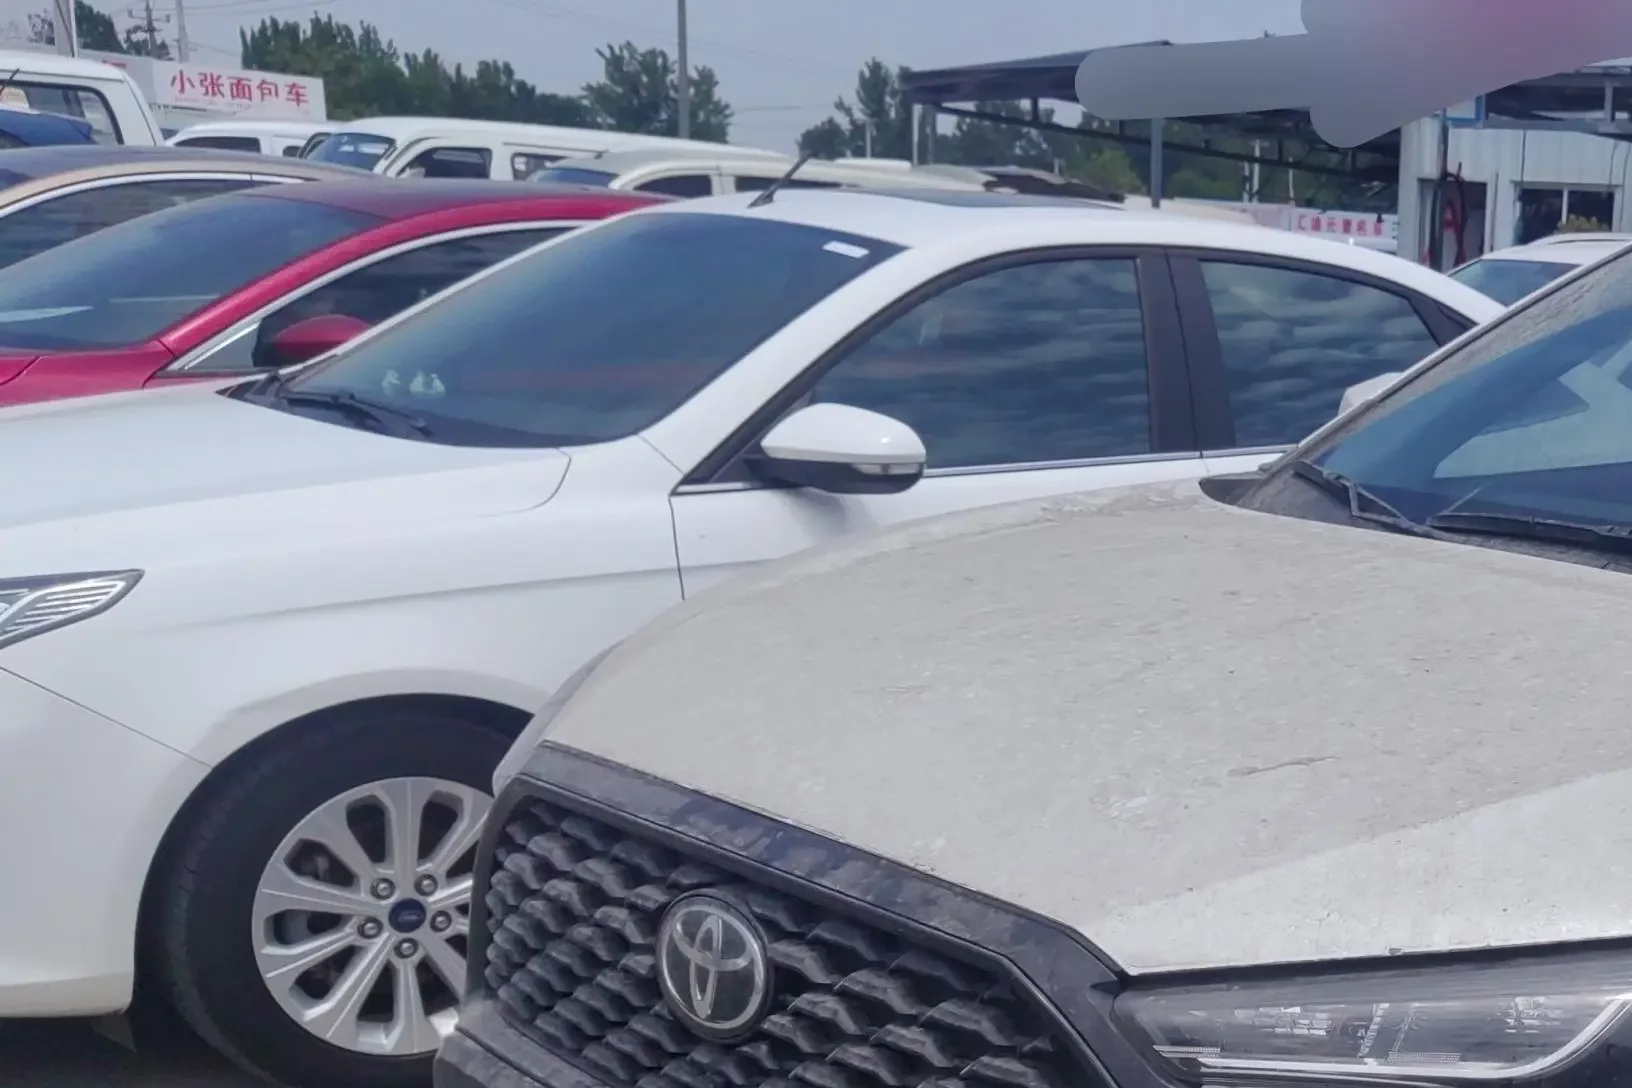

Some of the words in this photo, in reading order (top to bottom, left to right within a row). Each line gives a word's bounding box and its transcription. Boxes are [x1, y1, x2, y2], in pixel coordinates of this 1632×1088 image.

[170, 69, 309, 107] 小张面包车
